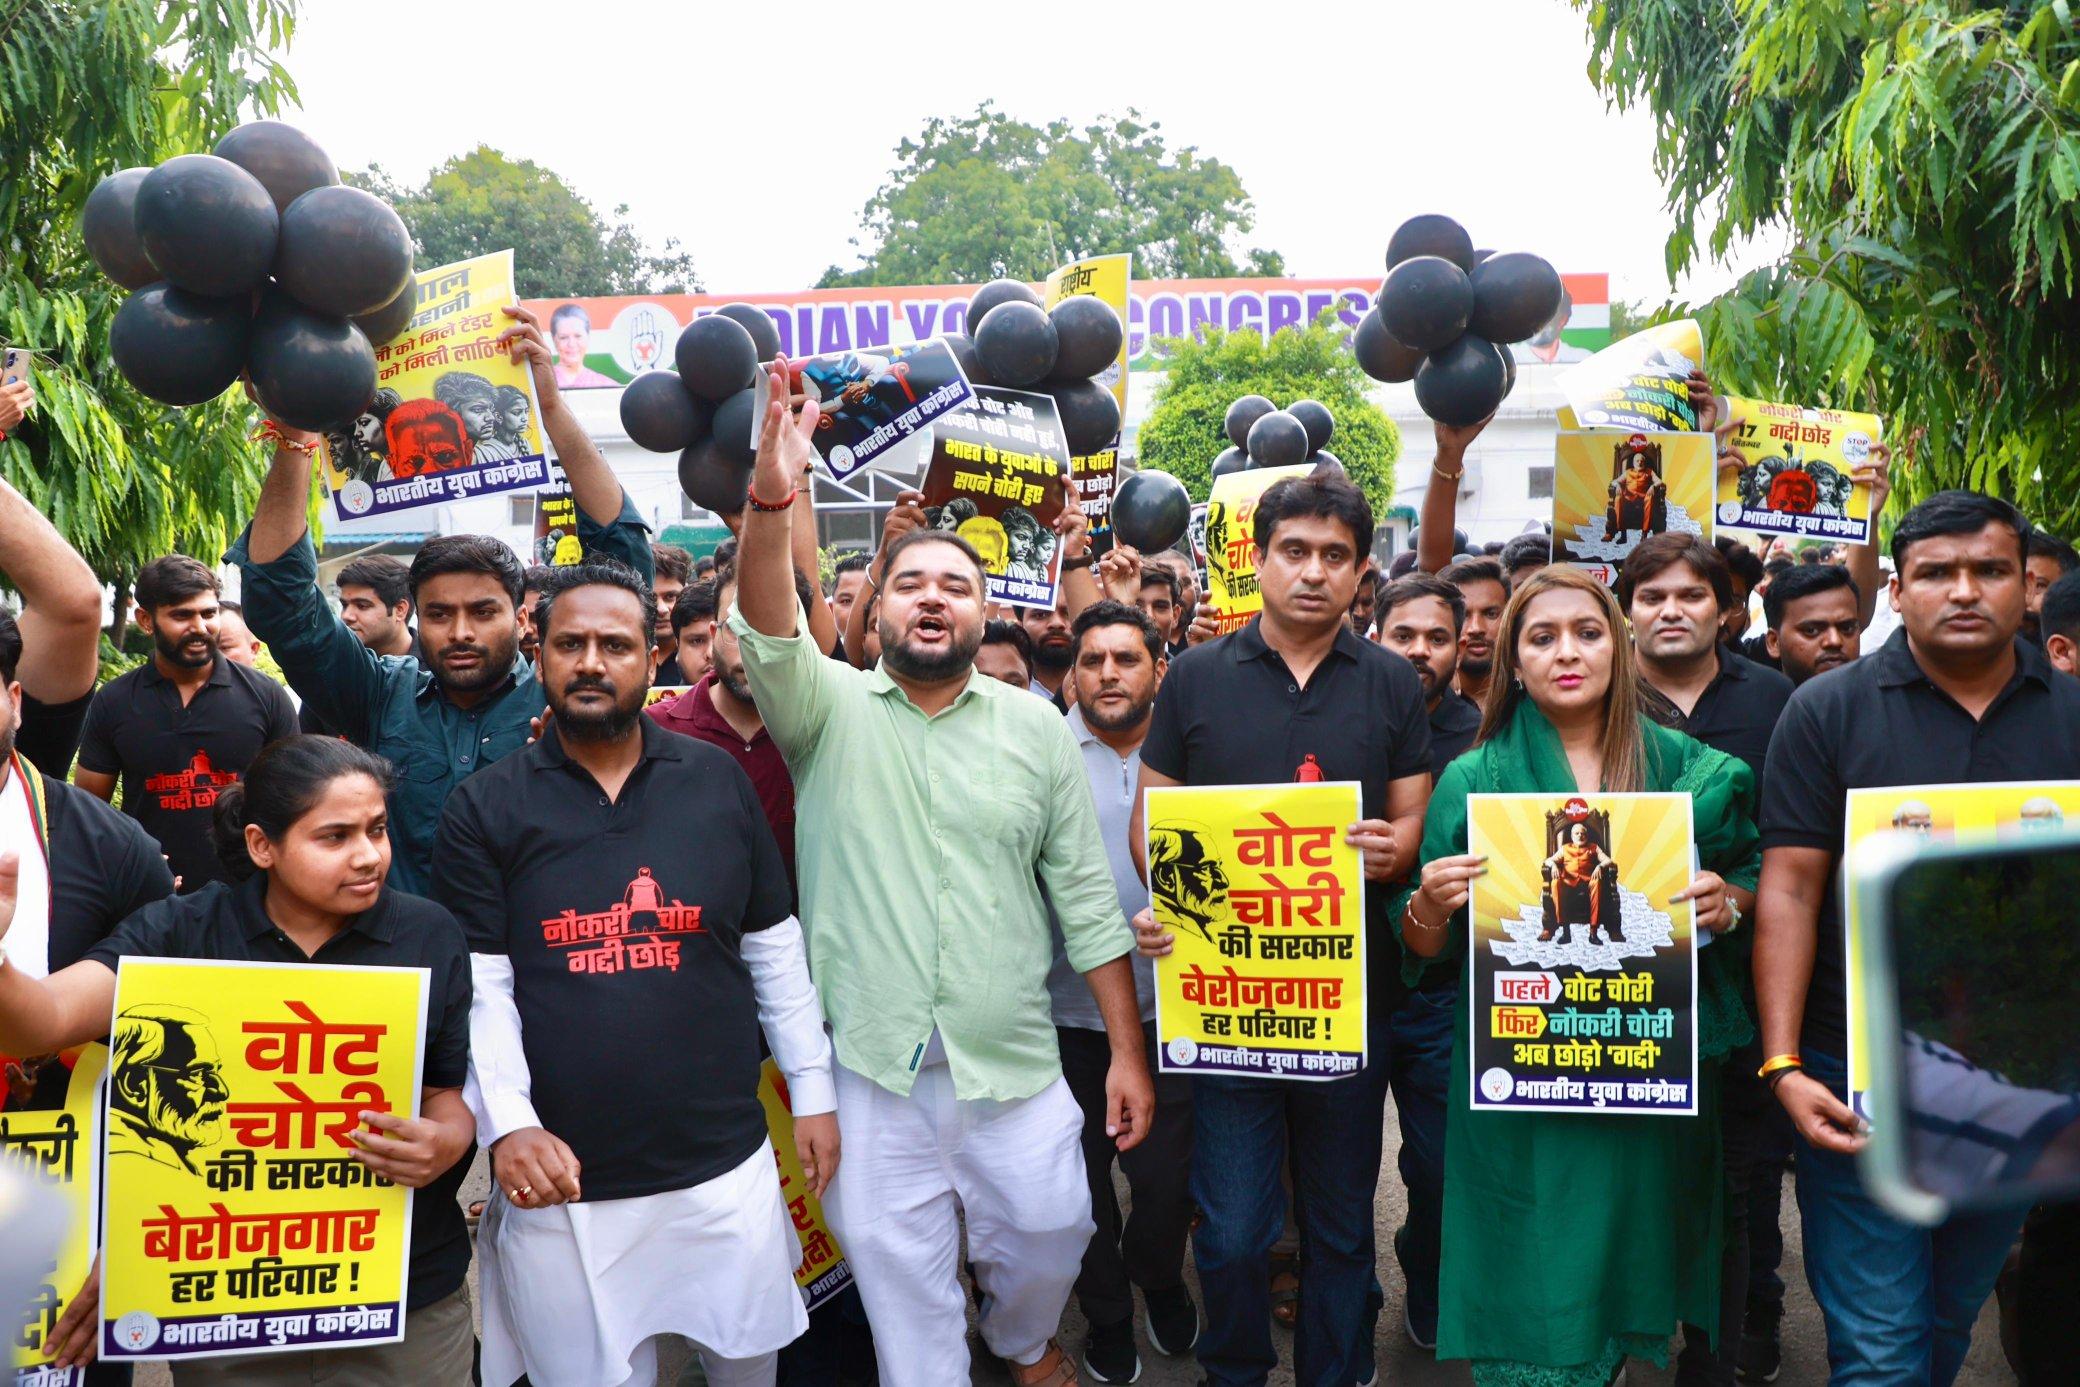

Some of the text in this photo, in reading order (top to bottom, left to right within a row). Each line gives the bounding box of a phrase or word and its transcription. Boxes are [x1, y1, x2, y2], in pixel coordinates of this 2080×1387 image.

[379, 362, 400, 381] को
[404, 344, 449, 371] मिली
[852, 379, 965, 460] भारतीय युवा कांग्रेस
[1739, 423, 1758, 438] 17
[1802, 424, 1832, 448] छोड़
[945, 438, 982, 462] भारत
[983, 442, 998, 465] के
[1044, 455, 1058, 476] के
[1847, 437, 1869, 446] STOP
[376, 474, 444, 505] भारतीय
[446, 469, 483, 498] युवा
[483, 459, 543, 485] कांग्रेस
[953, 471, 1045, 507] सपने चोरी हुए
[1742, 509, 1864, 536] भारतीय युवा कांग्रेस
[1007, 578, 1051, 601] कांग्रेस
[1233, 812, 1336, 868] वोट
[1228, 871, 1345, 927] चोरी
[541, 899, 702, 942] नौकरी चोर
[566, 935, 681, 974] गद्दी छोड़
[1217, 925, 1355, 960] की सरकार
[1179, 964, 1343, 1009] बेरोजगार
[1500, 972, 1654, 1003] पहले वोट चोरी
[242, 1000, 387, 1077] वोट
[1200, 1009, 1332, 1040] हर परिवार !
[1496, 1006, 1675, 1039] फिर नौकरी चोरी
[1200, 1046, 1358, 1074] भारतीय युवा कांग्रेस
[1513, 1042, 1549, 1068] अब
[1552, 1039, 1603, 1073] छोड़ो
[1515, 1076, 1688, 1108] भारतीय युवा कांग्रेस
[226, 1081, 392, 1150] चोरी
[206, 1149, 257, 1192] की
[141, 1202, 381, 1263] बेरोजगार
[170, 1256, 360, 1303] हर परिवार !
[163, 1305, 394, 1346] भारतीय युवा कांग्रेस
